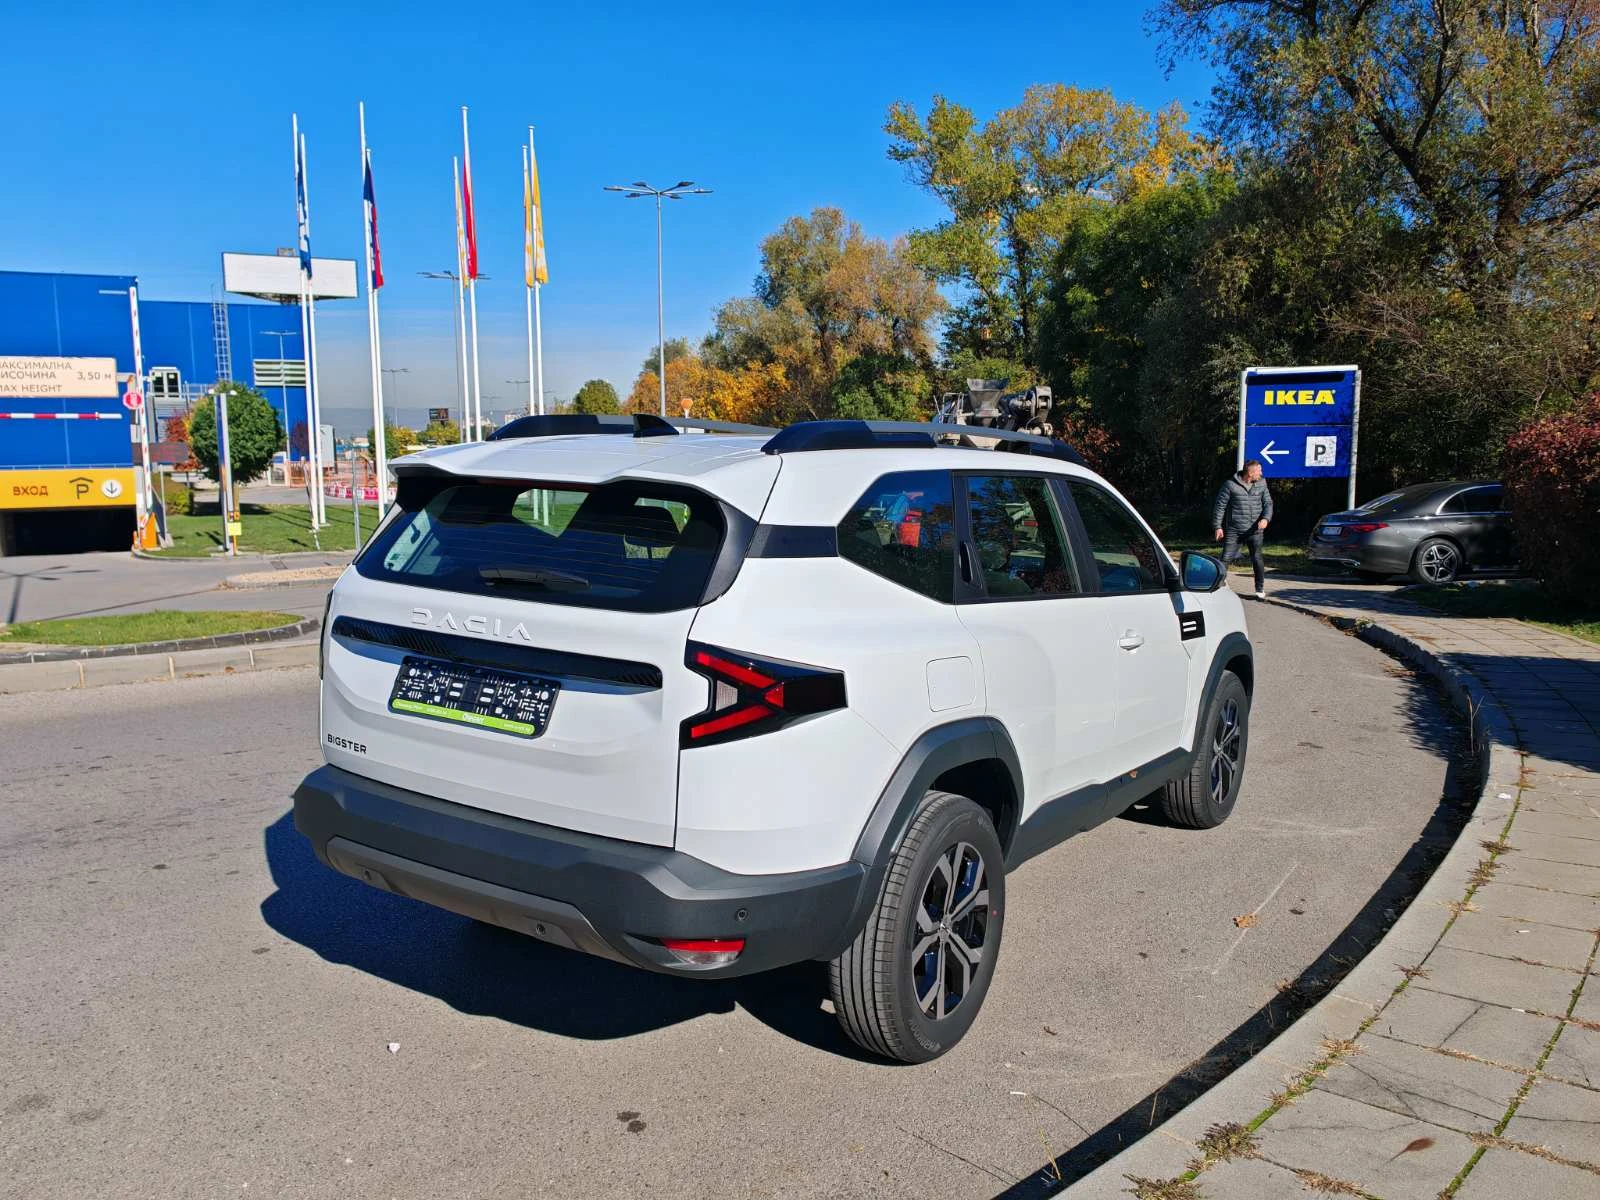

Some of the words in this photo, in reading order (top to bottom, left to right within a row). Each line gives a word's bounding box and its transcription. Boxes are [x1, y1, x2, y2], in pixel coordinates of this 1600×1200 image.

[0, 360, 73, 370] АКСИМАЛНА
[21, 384, 63, 393] HEIGHT
[1264, 390, 1335, 405] IKEA
[1313, 444, 1327, 461] P
[13, 485, 49, 496] ВХОД
[411, 607, 531, 640] DACIA
[327, 733, 367, 754] BIGSTER
